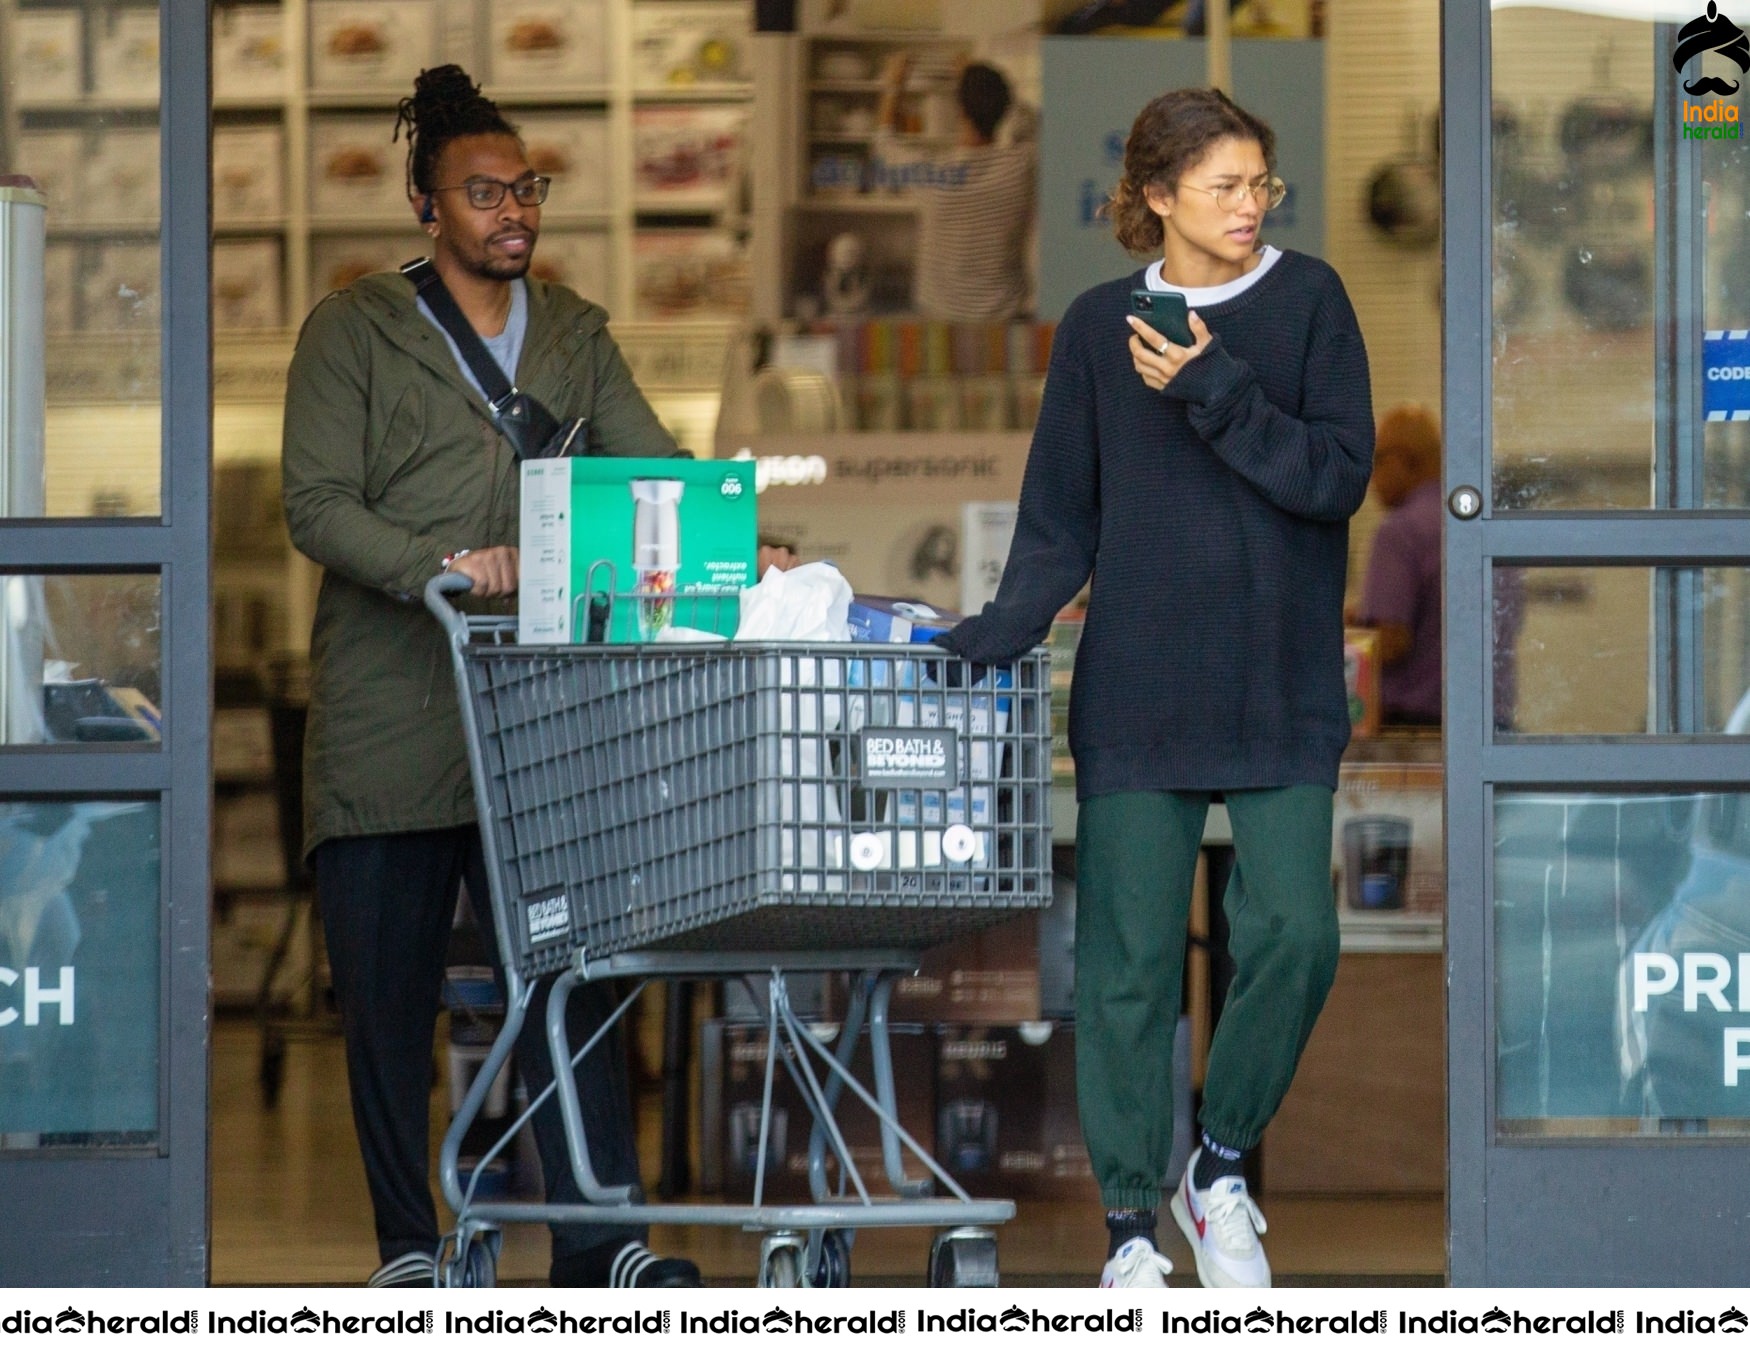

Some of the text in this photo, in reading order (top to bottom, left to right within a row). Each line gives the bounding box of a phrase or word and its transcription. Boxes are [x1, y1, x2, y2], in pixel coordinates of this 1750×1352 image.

[736, 447, 827, 495] yson
[866, 737, 945, 754] BED BATH &
[866, 753, 946, 768] BEYOND
